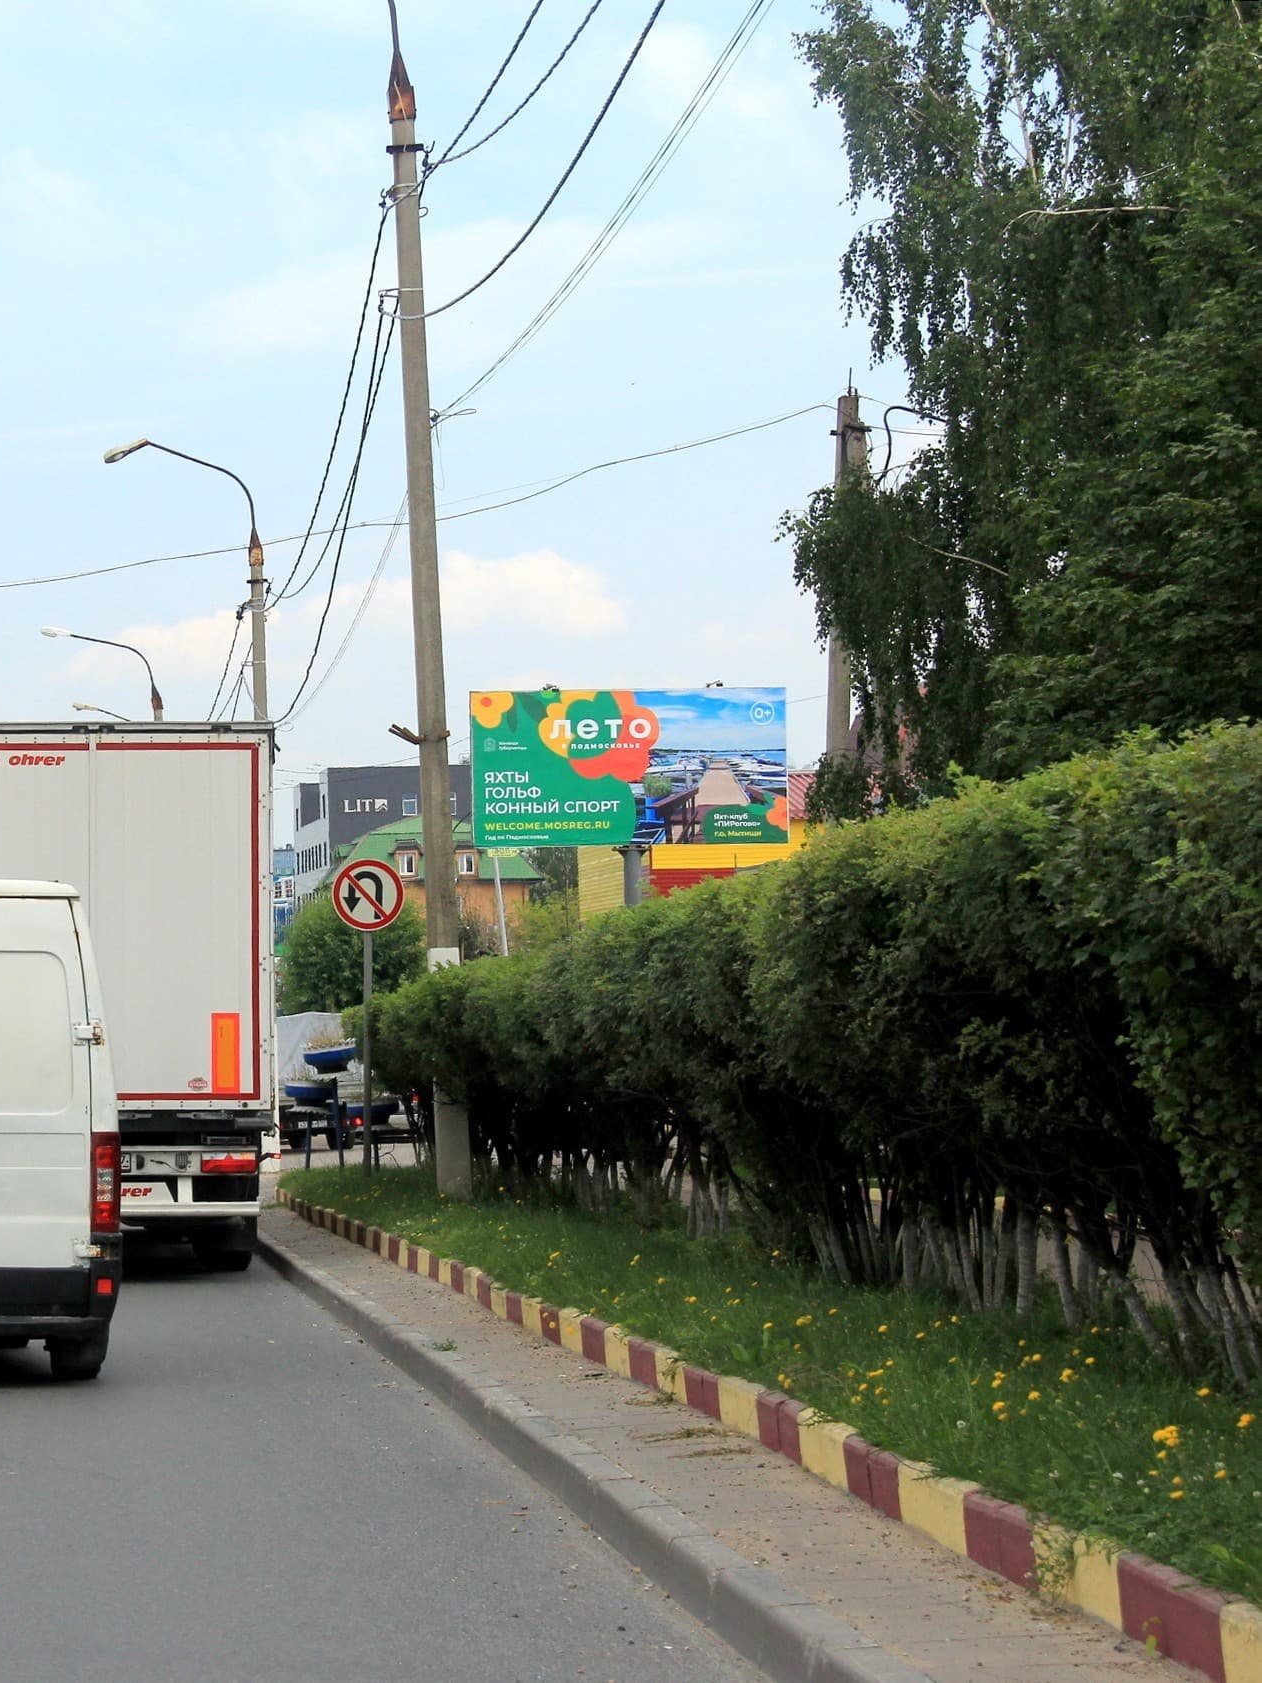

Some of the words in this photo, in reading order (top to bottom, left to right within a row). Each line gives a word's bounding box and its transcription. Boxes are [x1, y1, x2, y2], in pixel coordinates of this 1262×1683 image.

[754, 707, 772, 719] 0+
[484, 771, 529, 784] ЯХТЫ
[485, 786, 542, 799] ГОЛЬФ
[485, 798, 559, 815] КОННЫЙ
[564, 800, 620, 814] СПОРТ
[484, 821, 611, 831] WELCOME.MOSREG.RU
